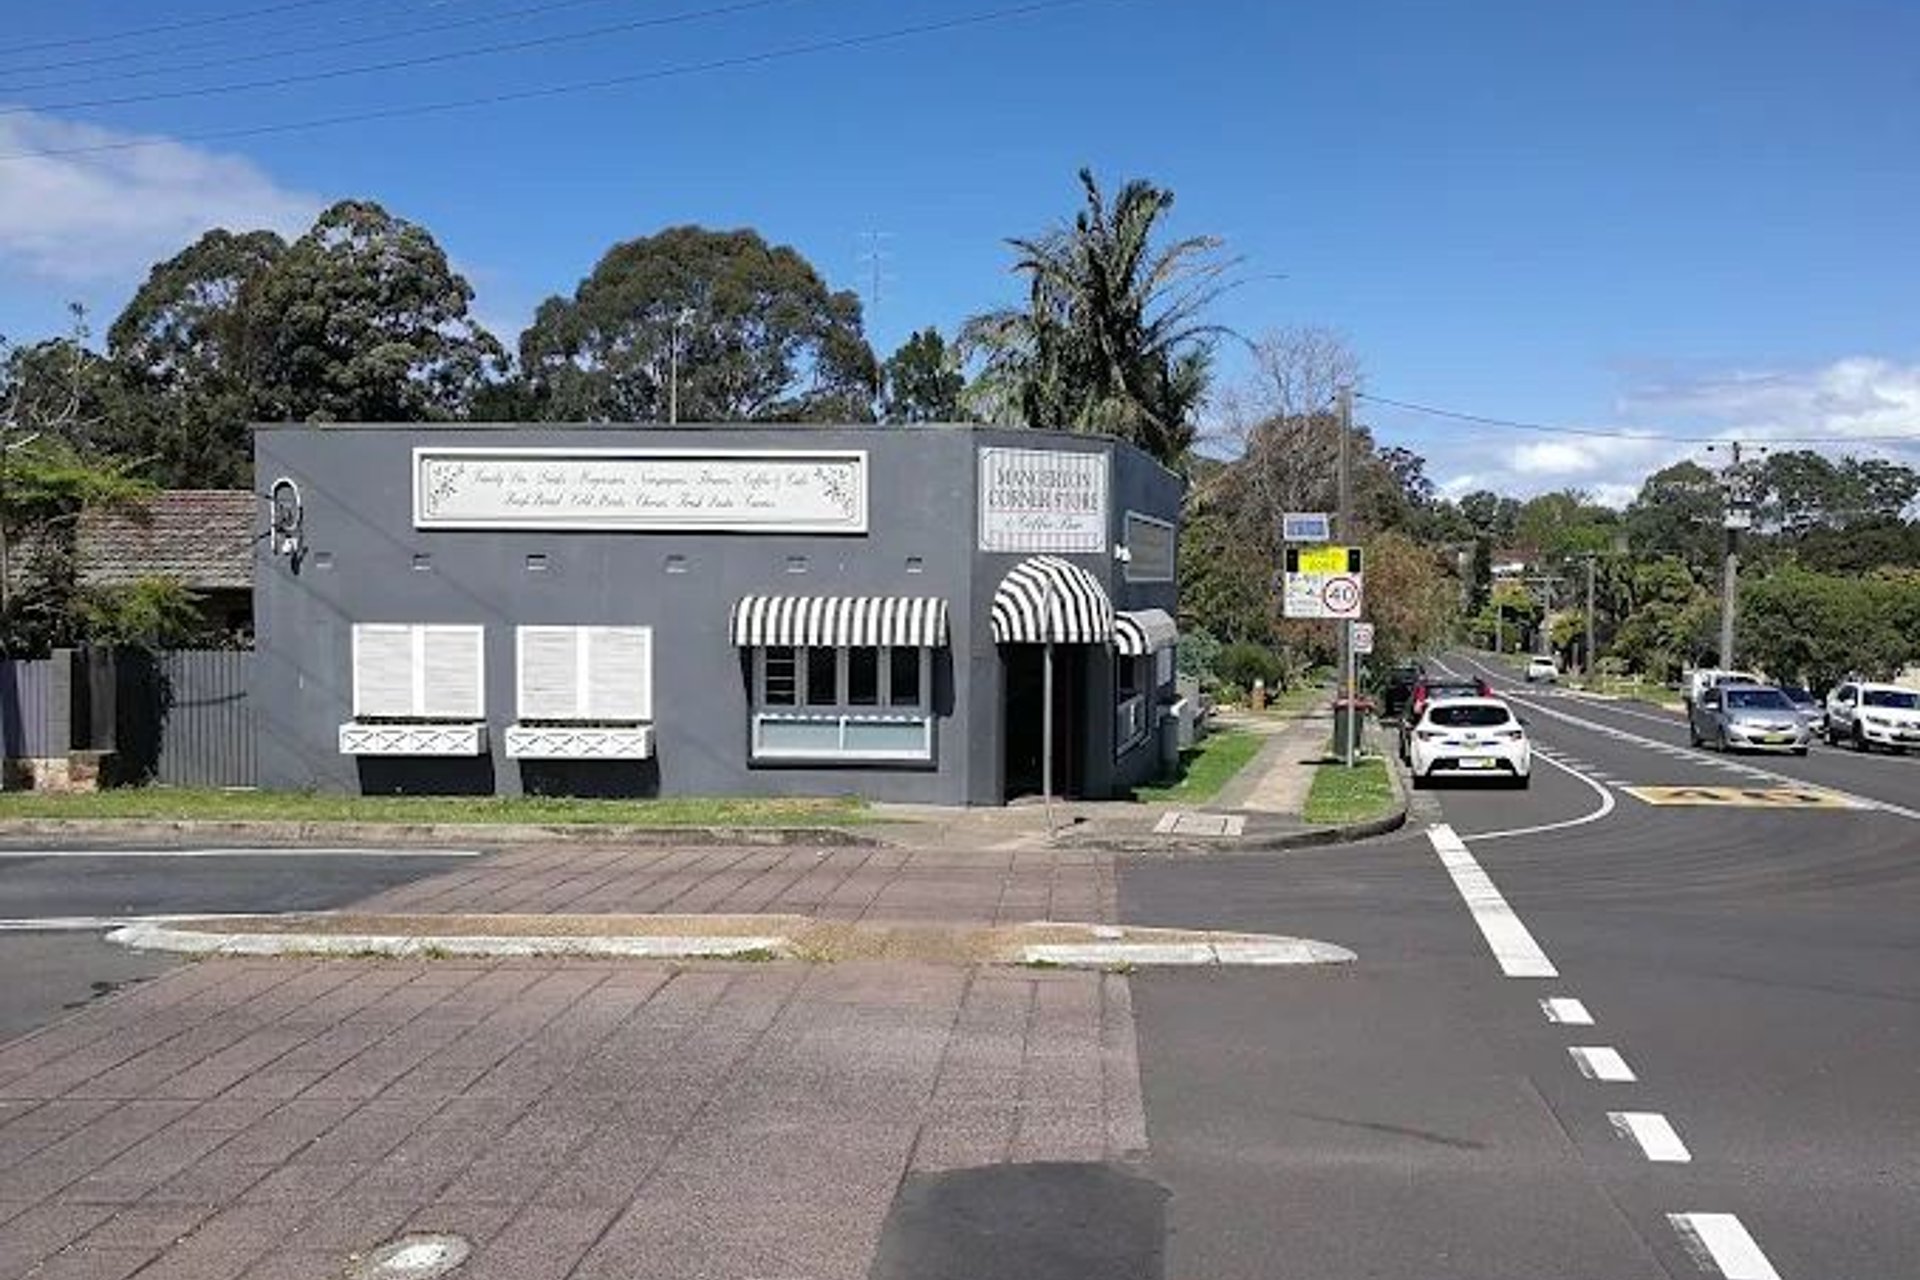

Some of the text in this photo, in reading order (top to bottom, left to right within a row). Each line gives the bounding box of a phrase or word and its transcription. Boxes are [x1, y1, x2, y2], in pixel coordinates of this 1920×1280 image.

[989, 489, 1098, 511] CORNER STORE
[1328, 585, 1355, 603] 40
